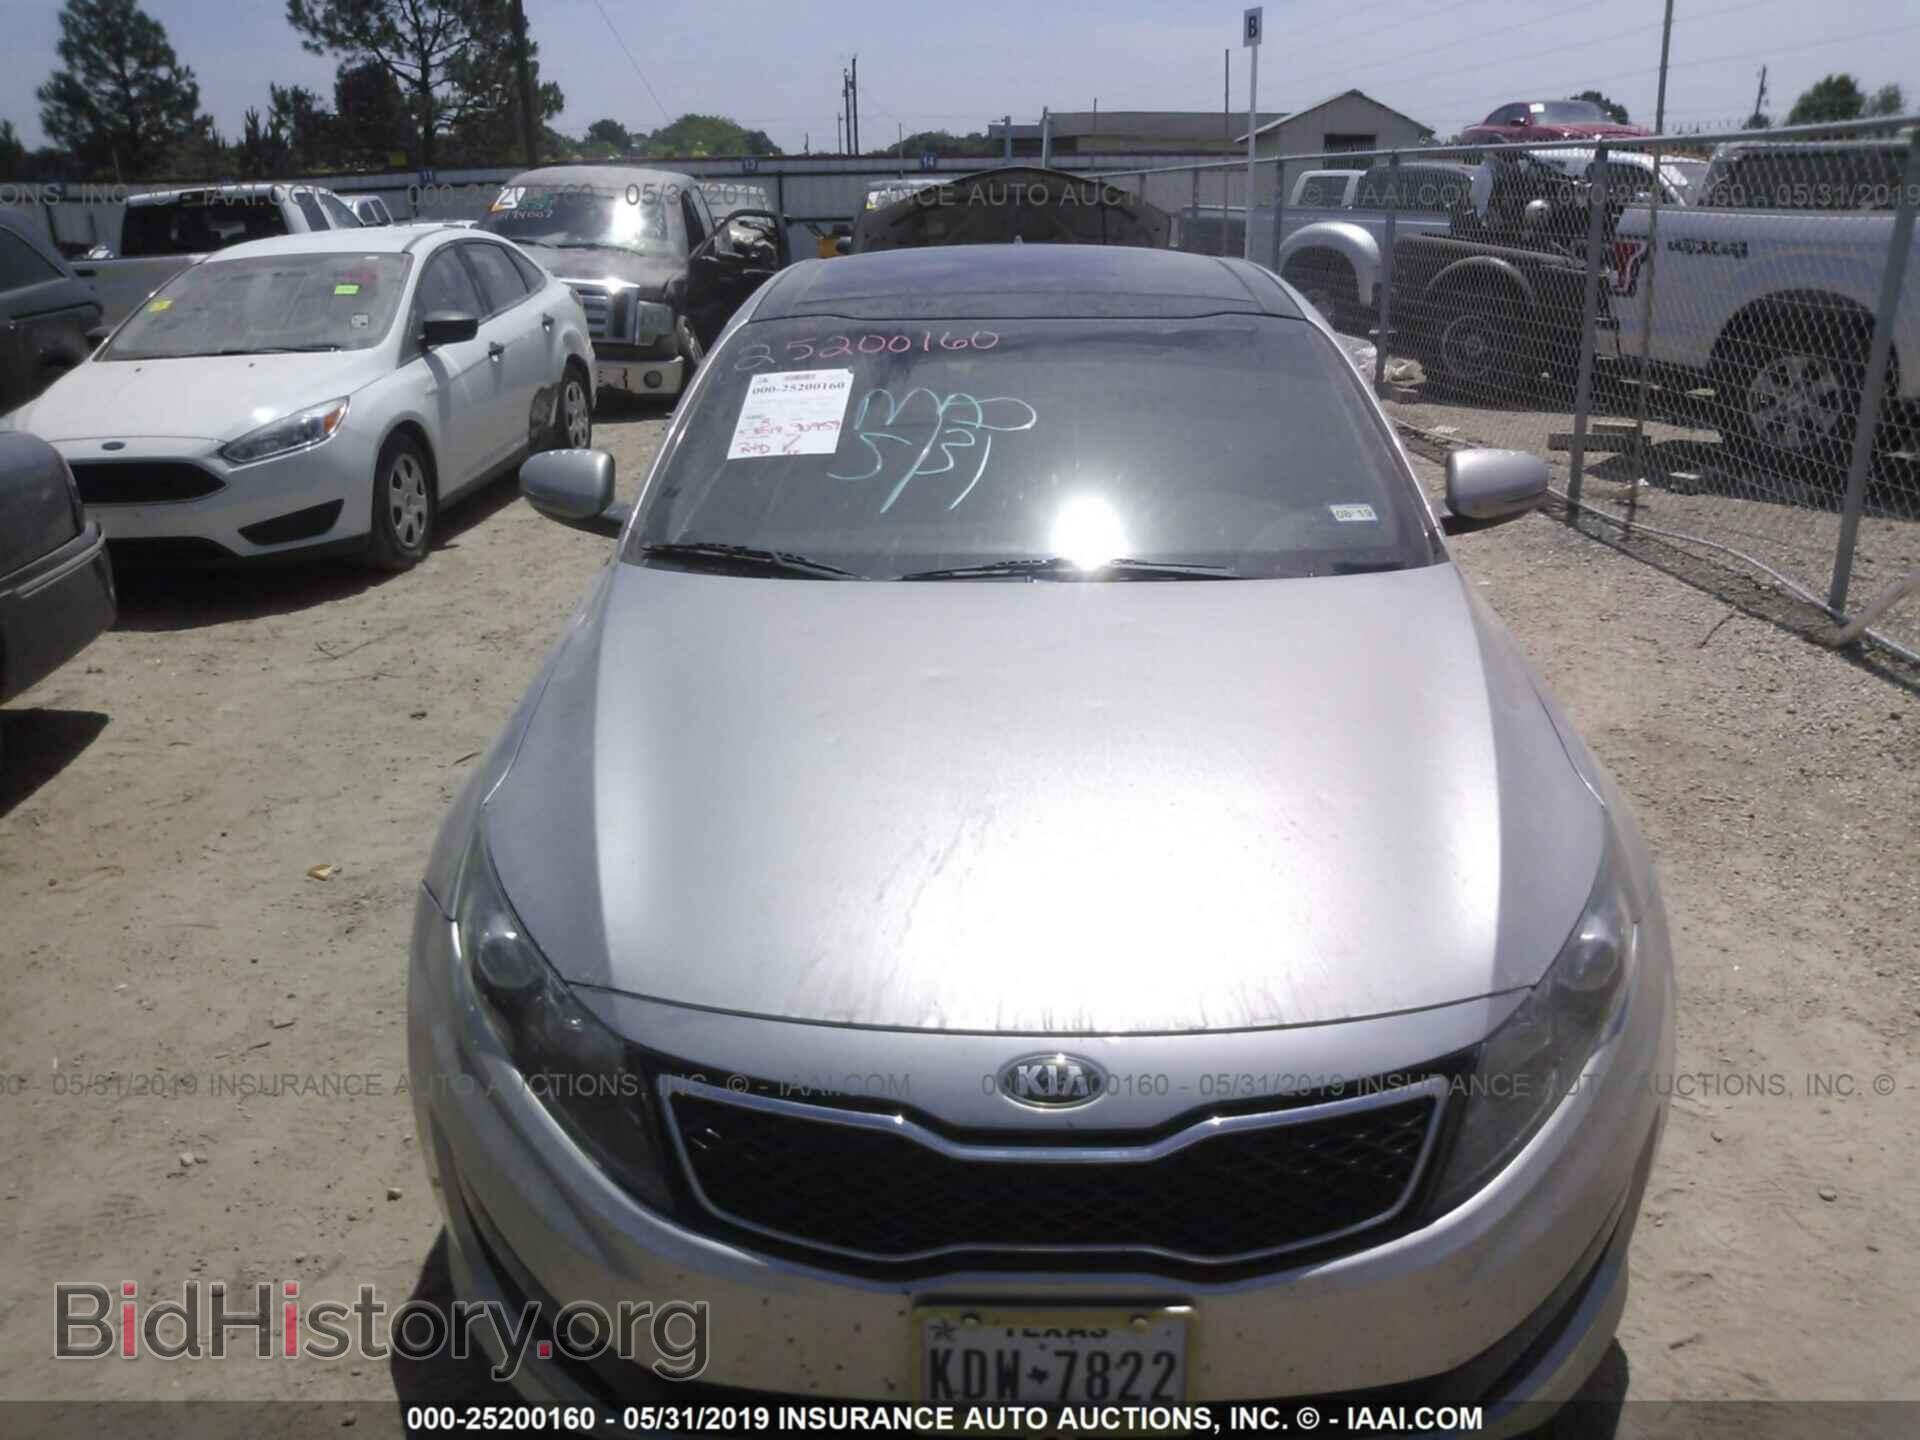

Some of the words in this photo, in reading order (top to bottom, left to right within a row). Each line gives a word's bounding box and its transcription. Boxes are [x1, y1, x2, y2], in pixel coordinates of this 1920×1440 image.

[1248, 16, 1258, 38] B
[734, 330, 999, 370] 25200160
[1017, 1065, 1090, 1096] KIA
[1054, 1350, 1177, 1400] 7822
